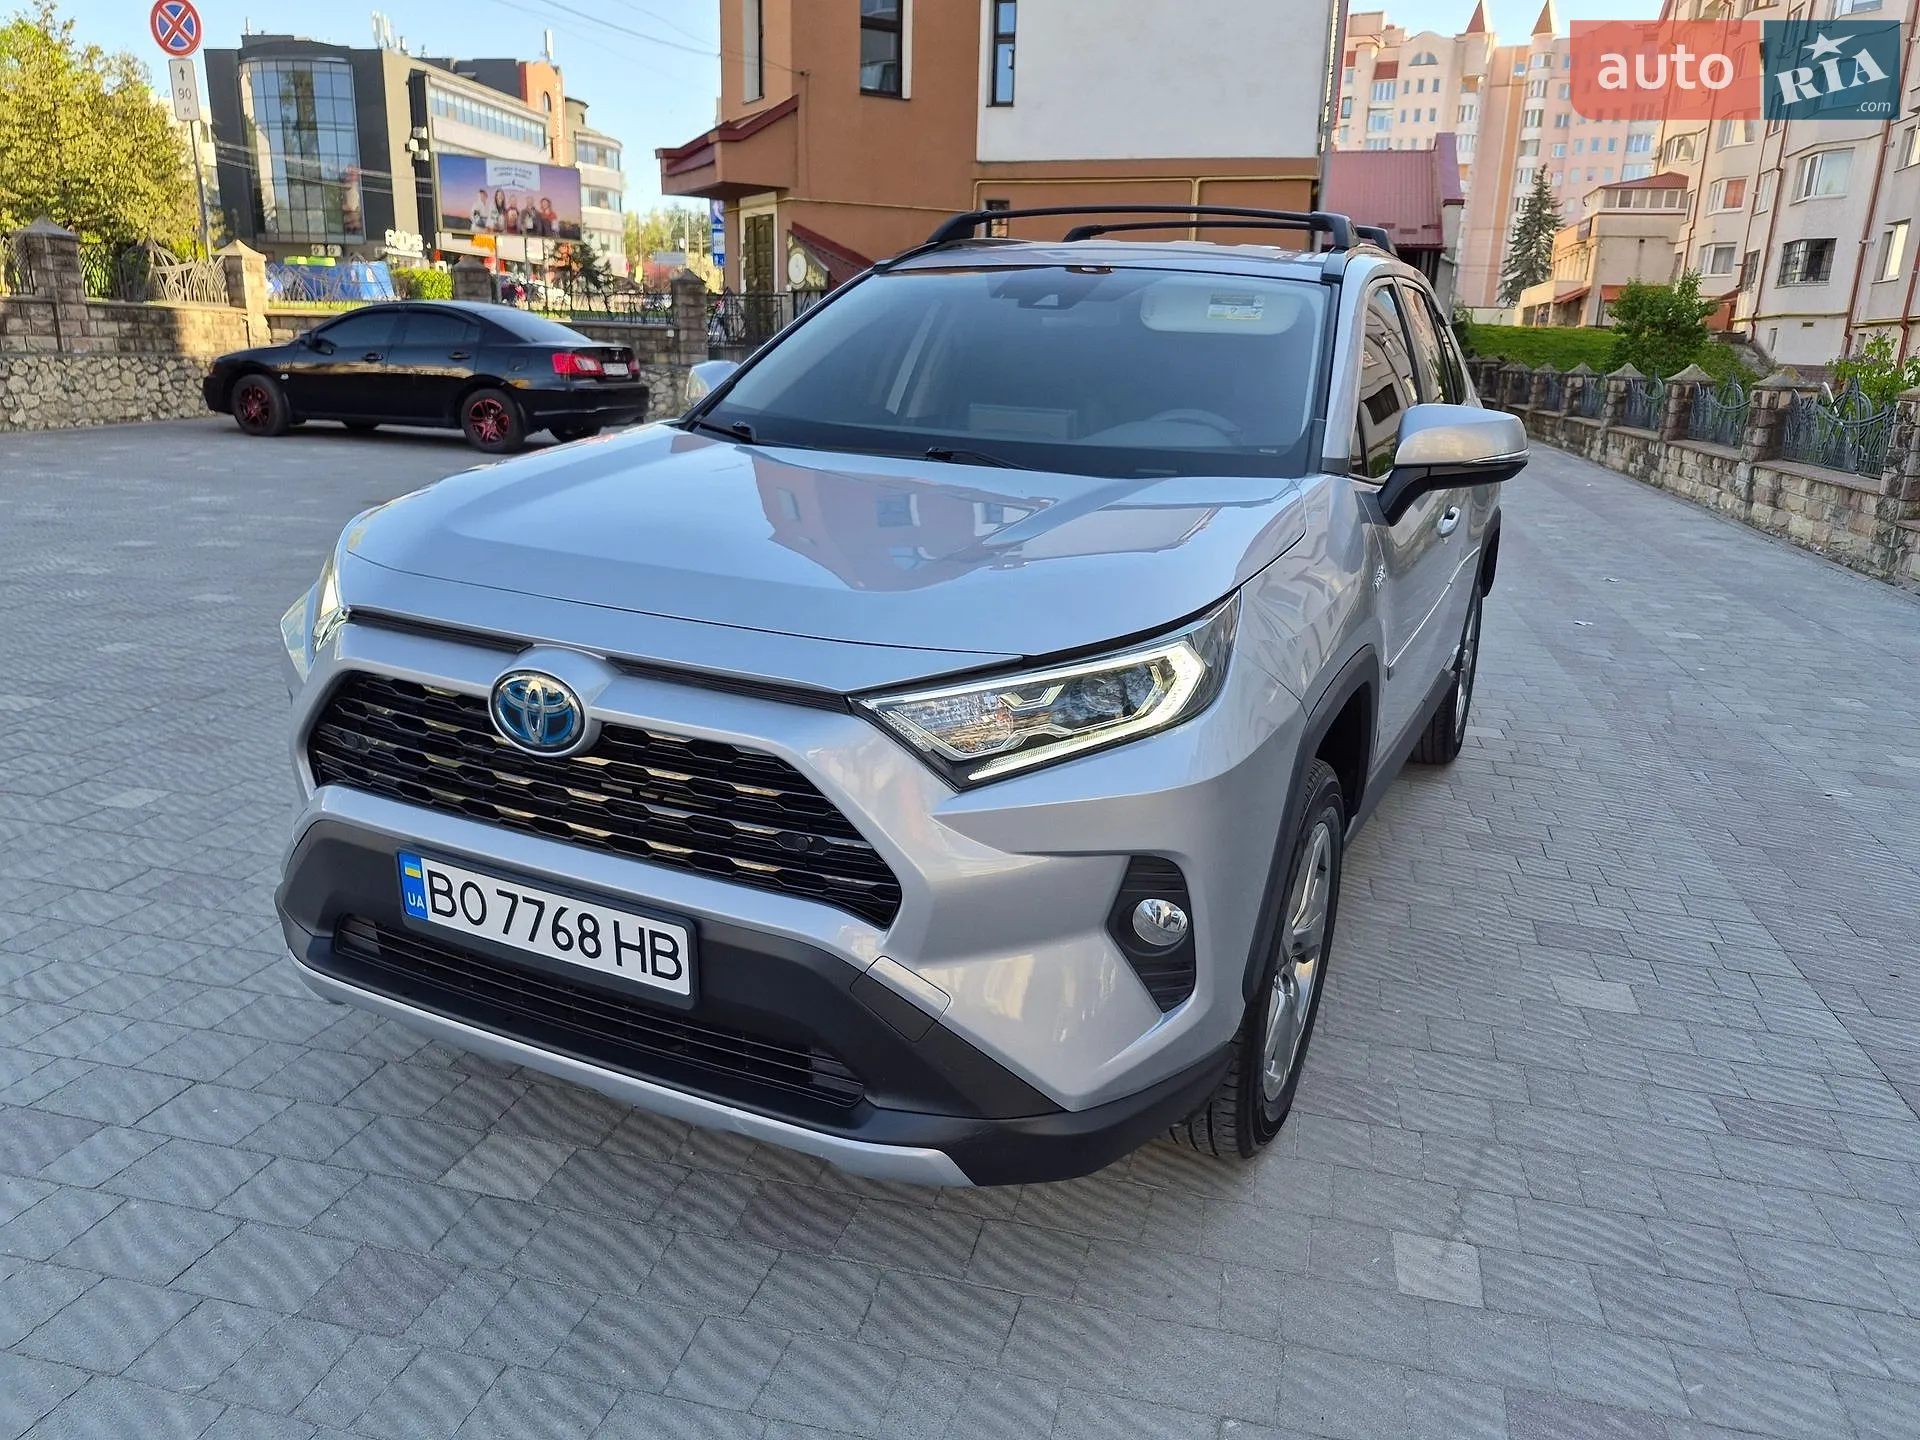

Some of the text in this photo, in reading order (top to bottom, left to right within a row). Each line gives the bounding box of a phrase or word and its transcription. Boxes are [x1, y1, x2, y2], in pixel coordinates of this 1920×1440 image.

[178, 87, 192, 101] 90
[408, 891, 425, 910] UA
[427, 869, 683, 981] BO 7768 HB
